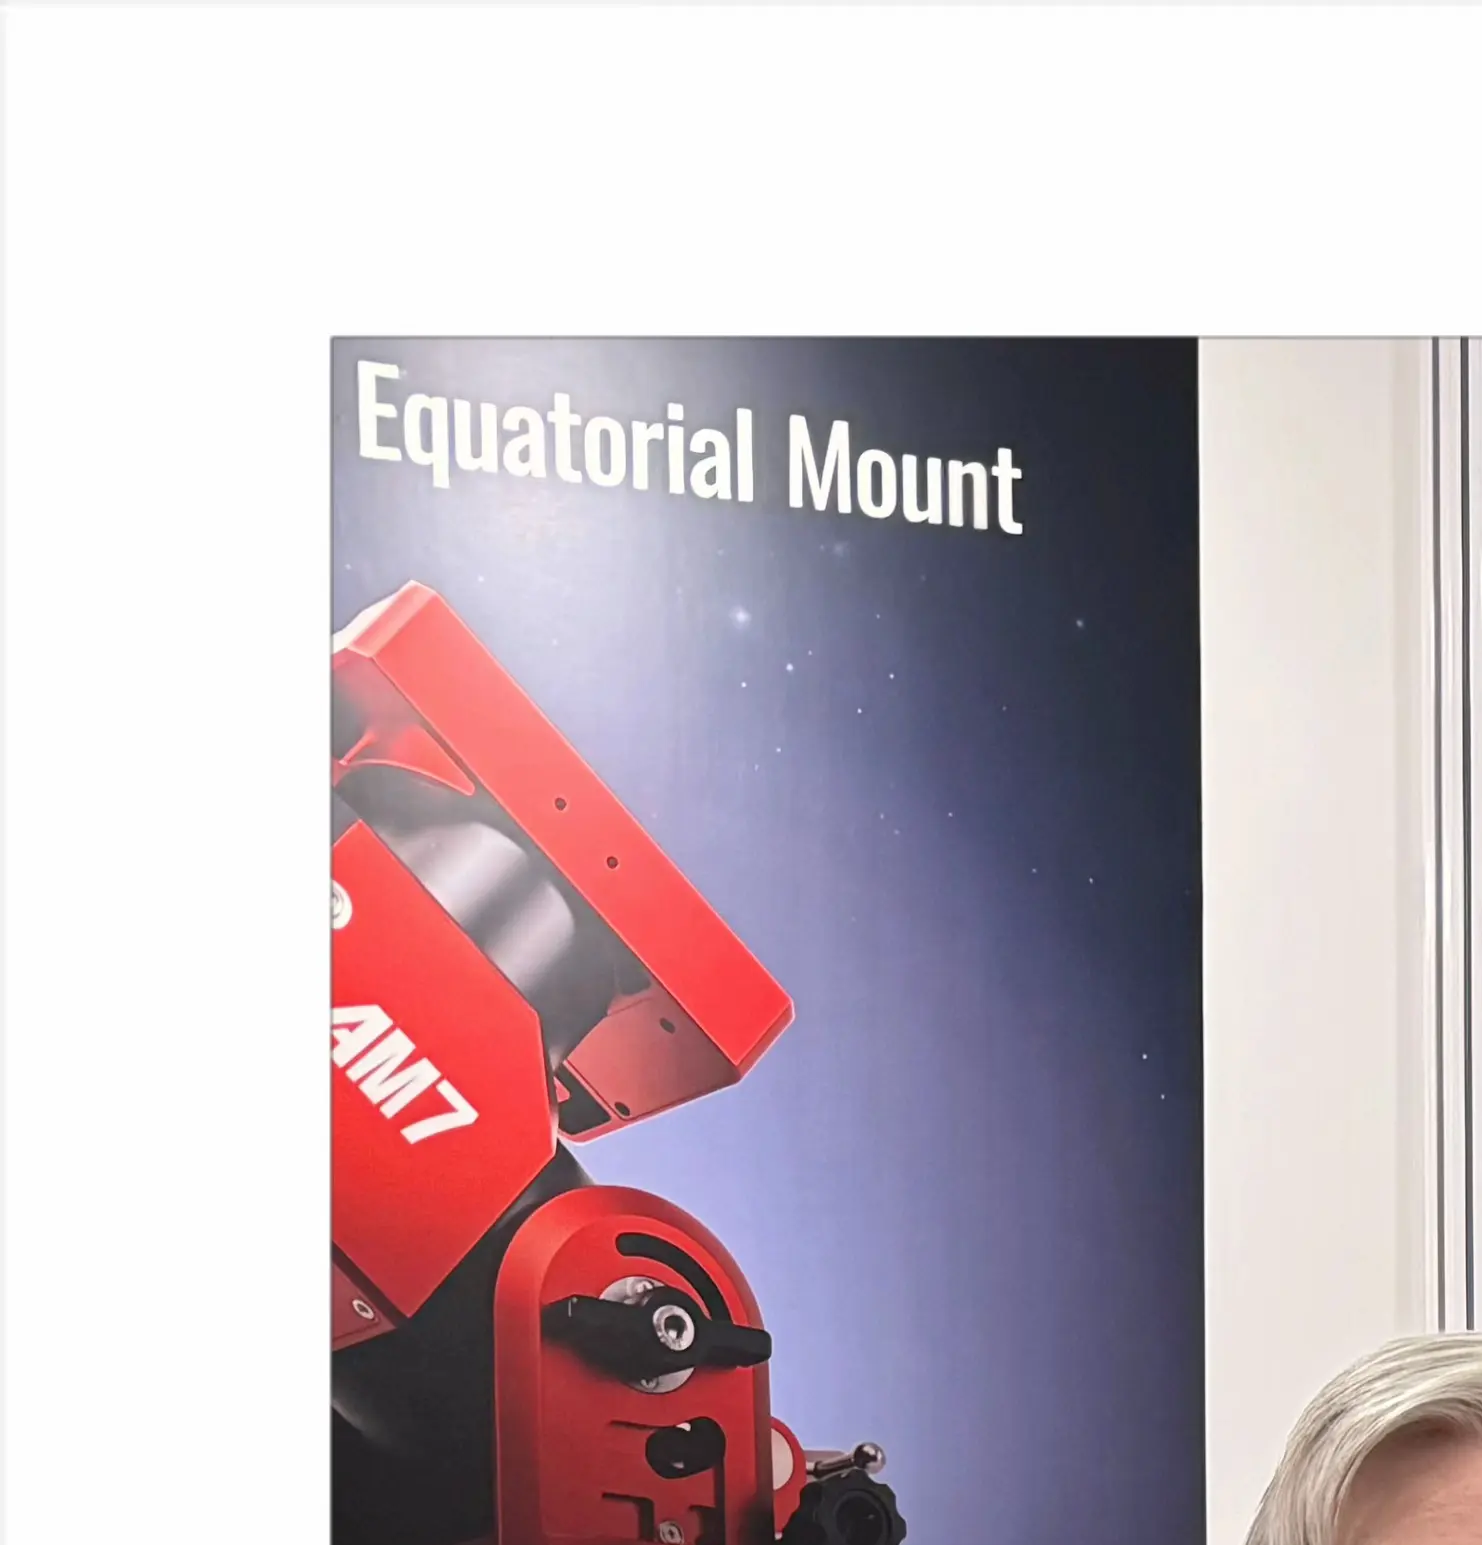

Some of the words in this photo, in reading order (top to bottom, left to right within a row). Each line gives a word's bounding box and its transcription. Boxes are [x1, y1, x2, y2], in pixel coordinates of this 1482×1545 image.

[357, 360, 754, 503] Equatorial
[789, 414, 1024, 536] Mount
[333, 1003, 479, 1145] AM7
